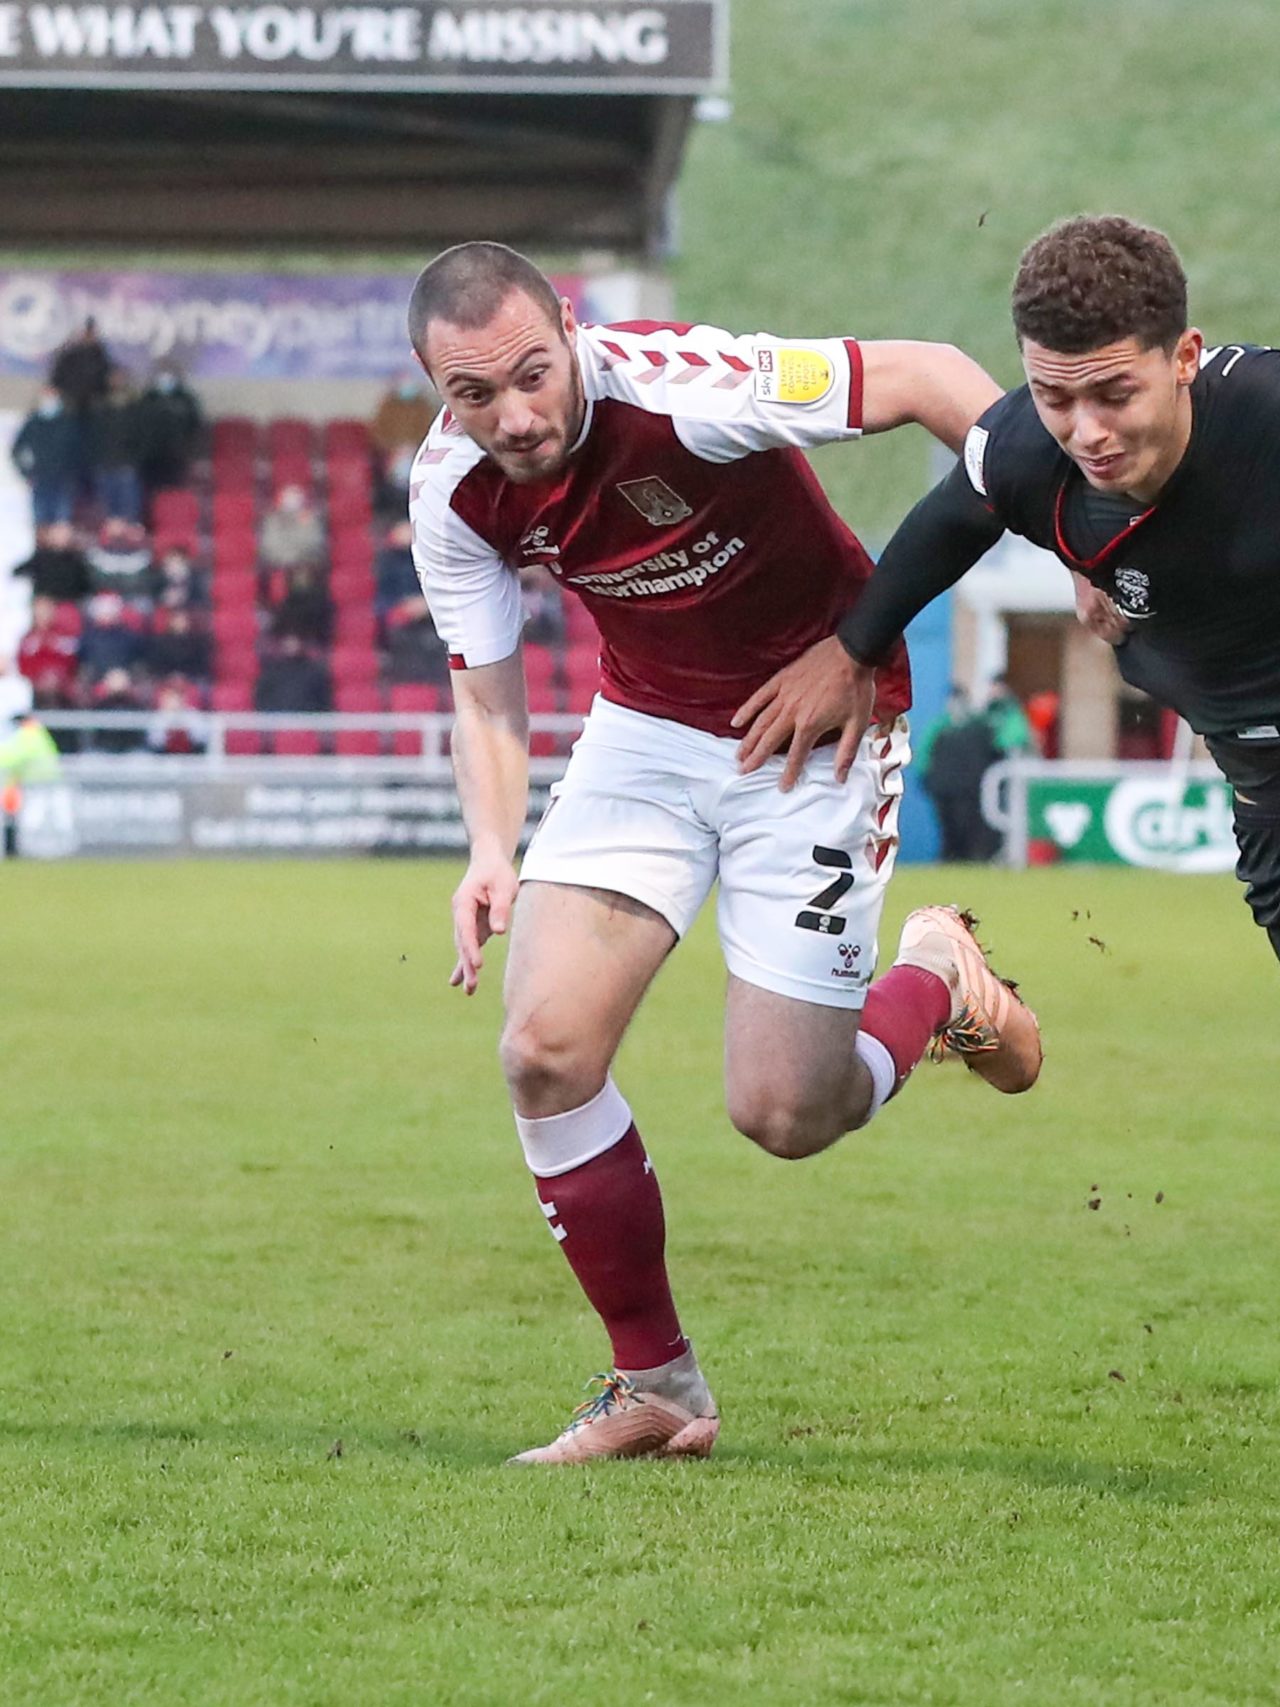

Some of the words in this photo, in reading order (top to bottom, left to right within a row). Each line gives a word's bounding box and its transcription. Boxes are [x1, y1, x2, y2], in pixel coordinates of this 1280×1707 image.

[29, 4, 202, 58] WHAT
[209, 5, 423, 61] YOU'RE
[428, 8, 669, 63] MISSING
[759, 352, 772, 371] bet
[761, 374, 774, 395] sky
[567, 549, 689, 585] University
[692, 531, 720, 553] of
[585, 536, 745, 597] Northampton
[795, 844, 854, 935] 2
